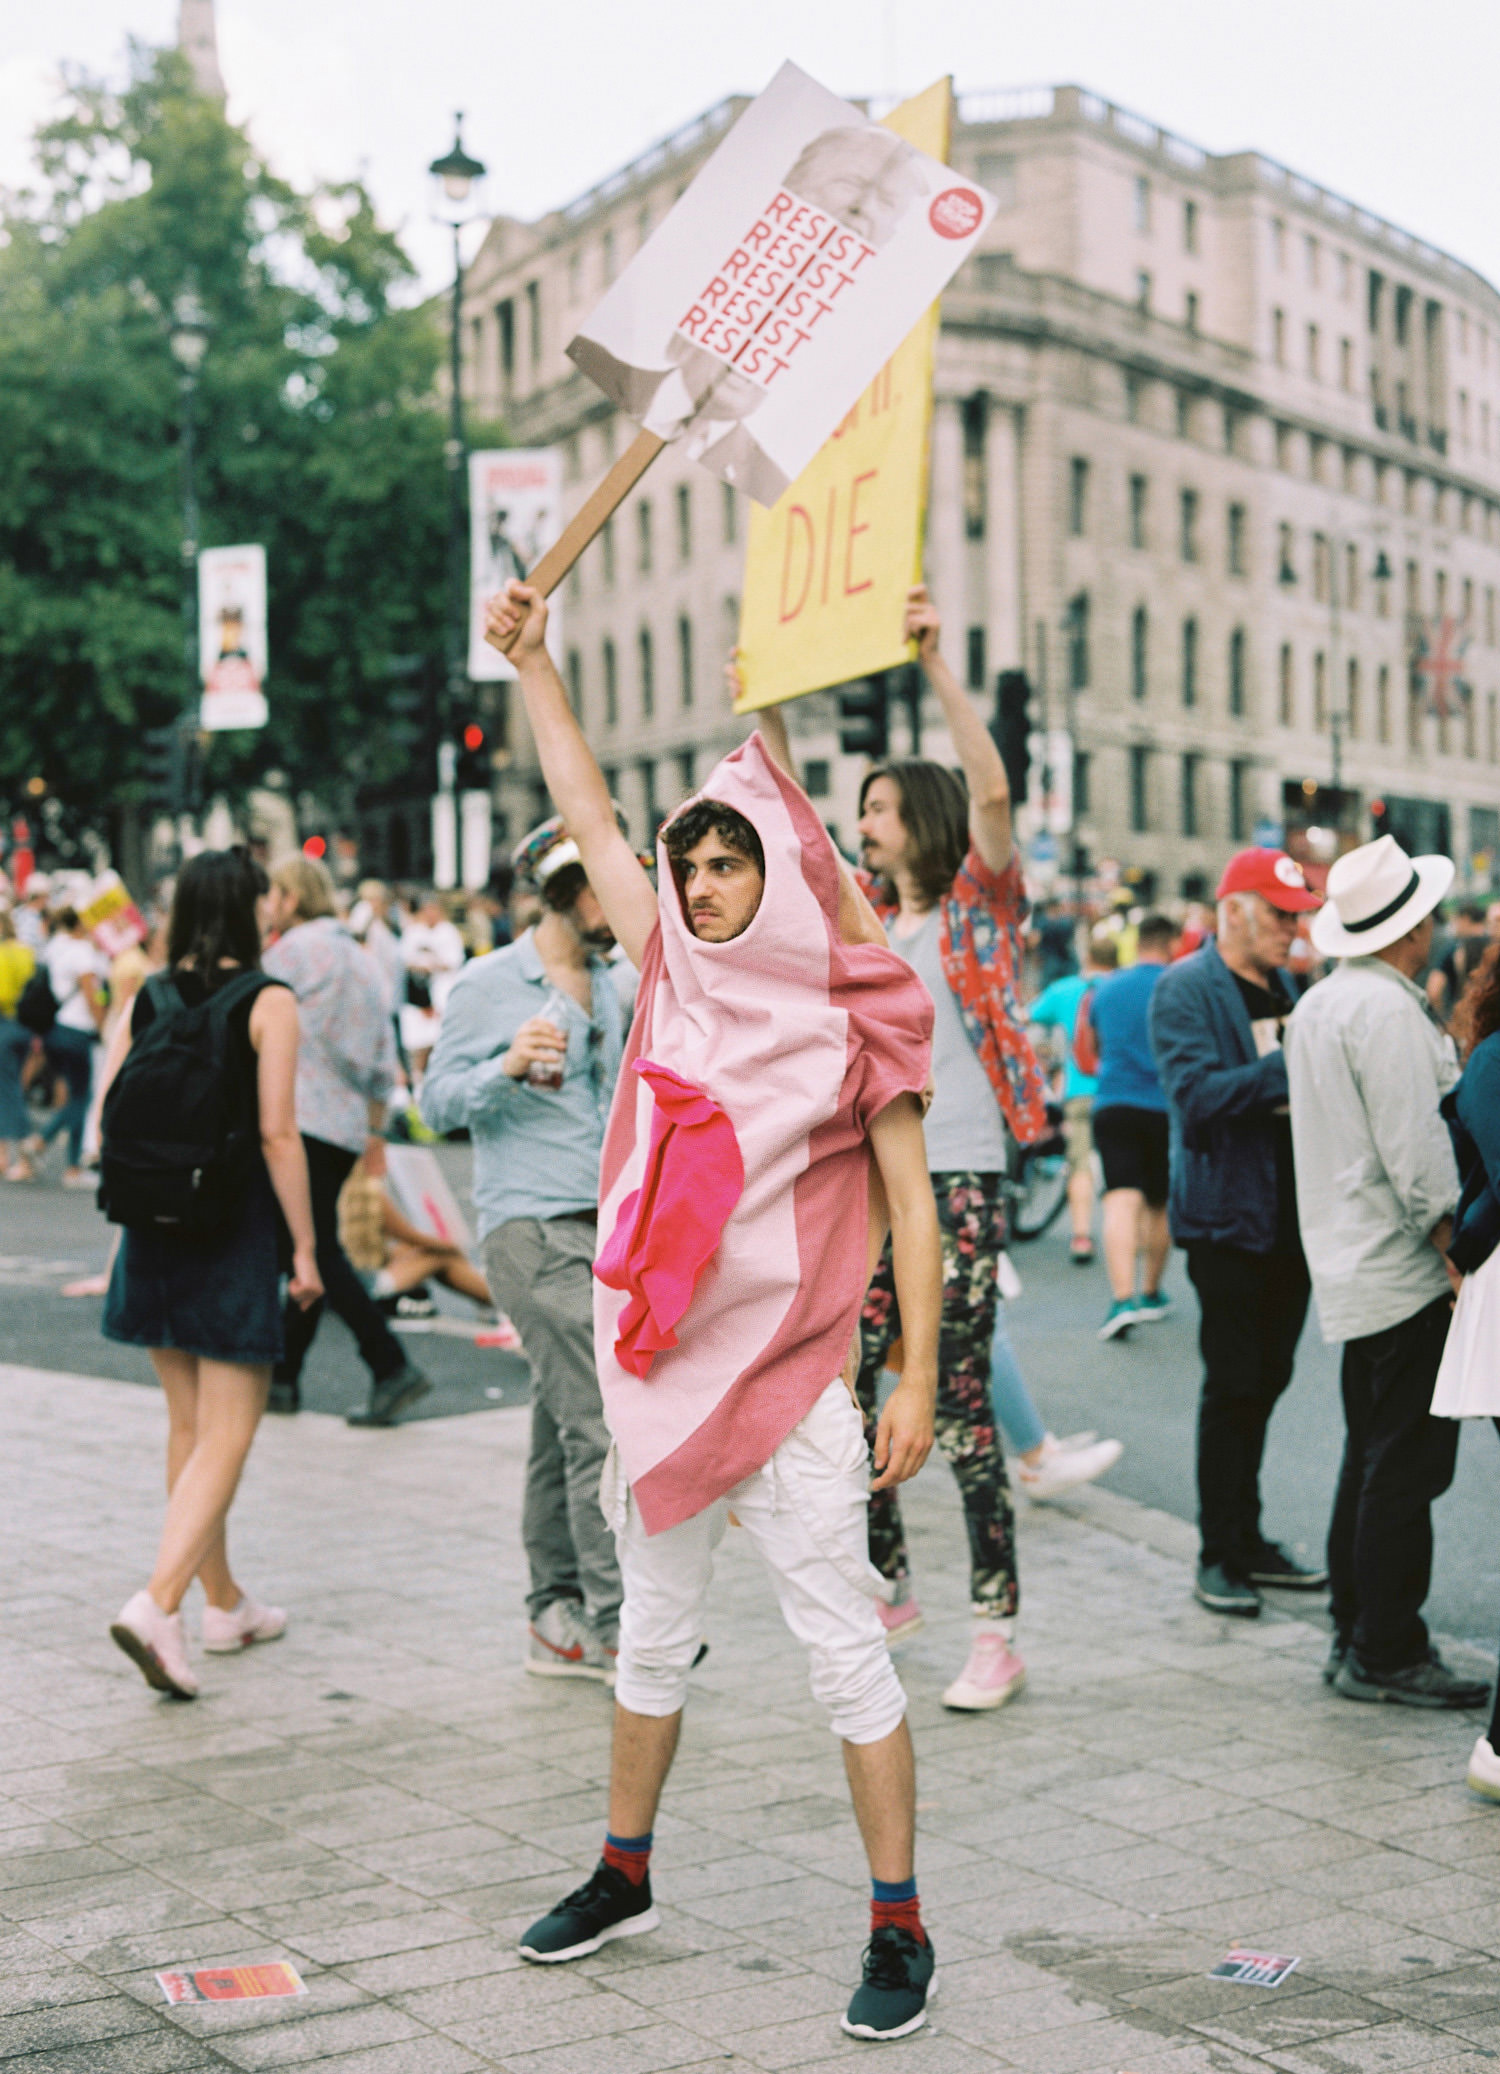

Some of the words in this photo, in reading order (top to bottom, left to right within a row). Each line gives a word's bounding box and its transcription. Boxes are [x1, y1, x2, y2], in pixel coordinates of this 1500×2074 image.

[742, 219, 855, 300] RESIST
[763, 190, 877, 273] RESIST
[699, 275, 812, 357] RESIST
[721, 247, 833, 329] RESIST
[677, 303, 790, 385] RESIST
[779, 468, 878, 624] DIE
